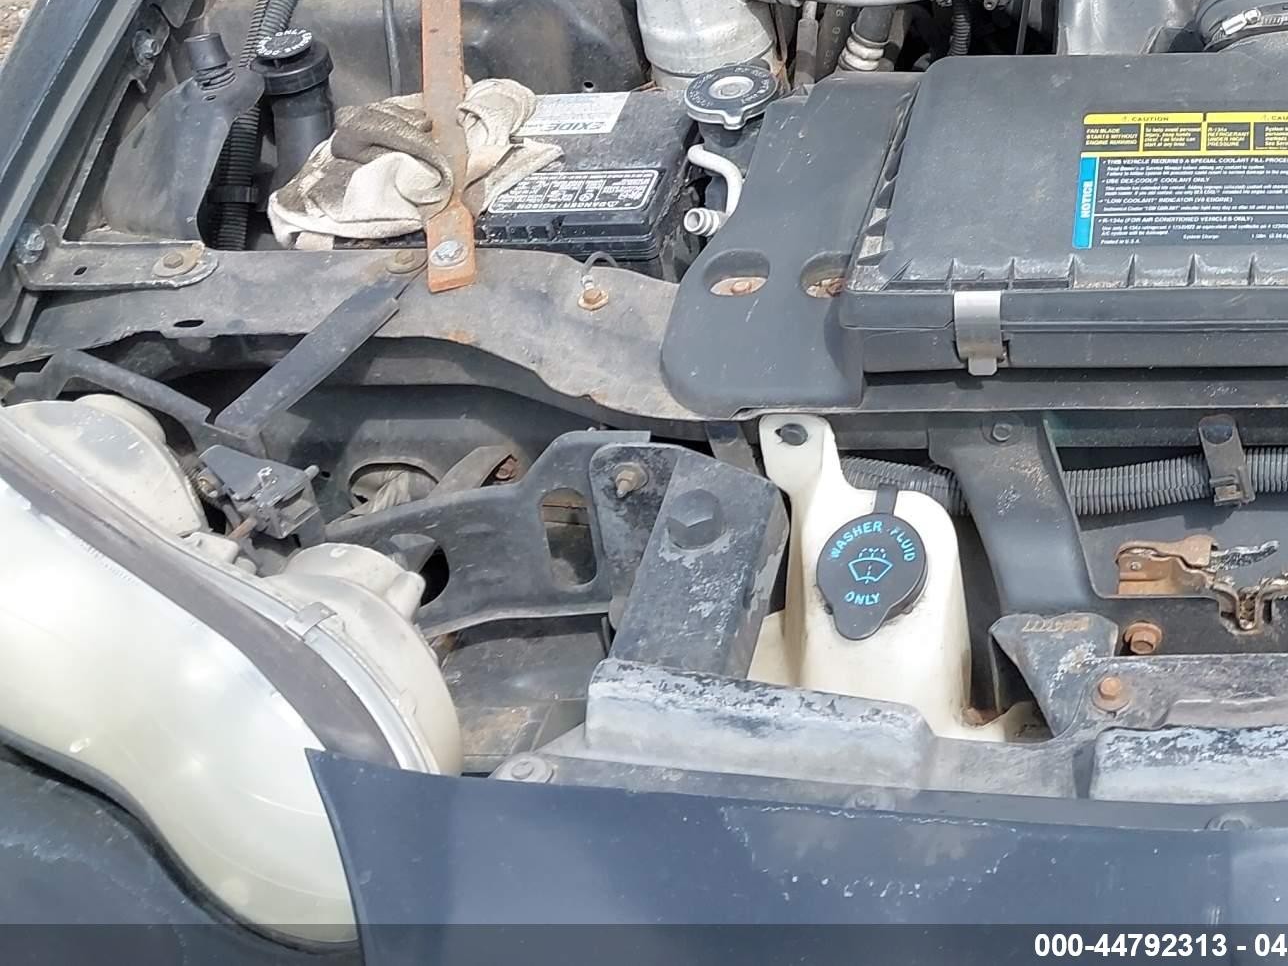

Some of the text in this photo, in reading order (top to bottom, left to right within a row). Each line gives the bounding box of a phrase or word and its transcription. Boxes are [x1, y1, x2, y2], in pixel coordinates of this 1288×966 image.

[544, 121, 606, 132] EXIDE
[569, 201, 607, 209] DANGER
[1080, 181, 1093, 218] NOTICE
[830, 521, 917, 562] WASHER FLUID
[844, 591, 880, 605] ONLY
